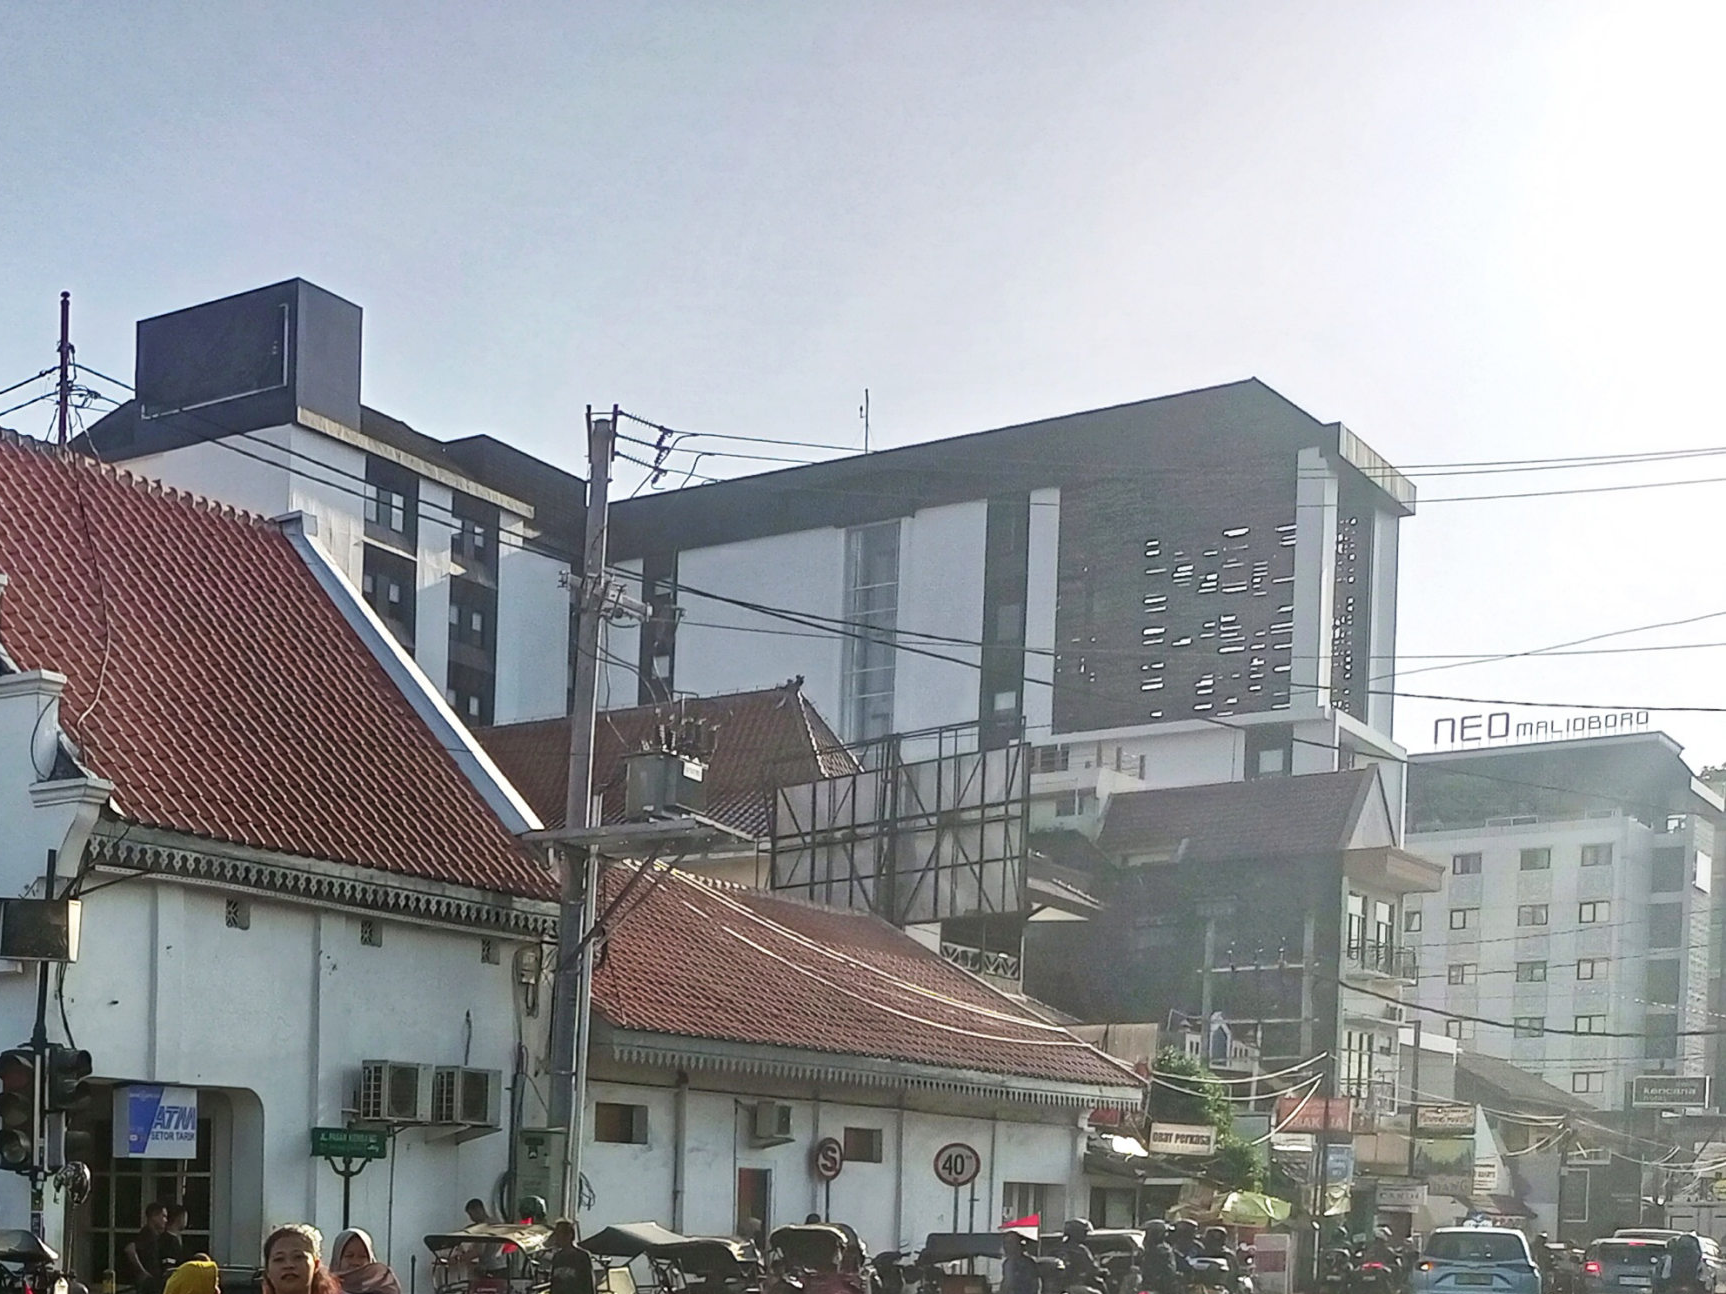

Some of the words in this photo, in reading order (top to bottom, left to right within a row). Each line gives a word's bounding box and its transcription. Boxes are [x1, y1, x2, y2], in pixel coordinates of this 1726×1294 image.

[1434, 712, 1510, 745] NEO
[154, 1105, 196, 1131] ATM
[821, 1145, 838, 1173] S
[941, 1153, 965, 1176] 40
